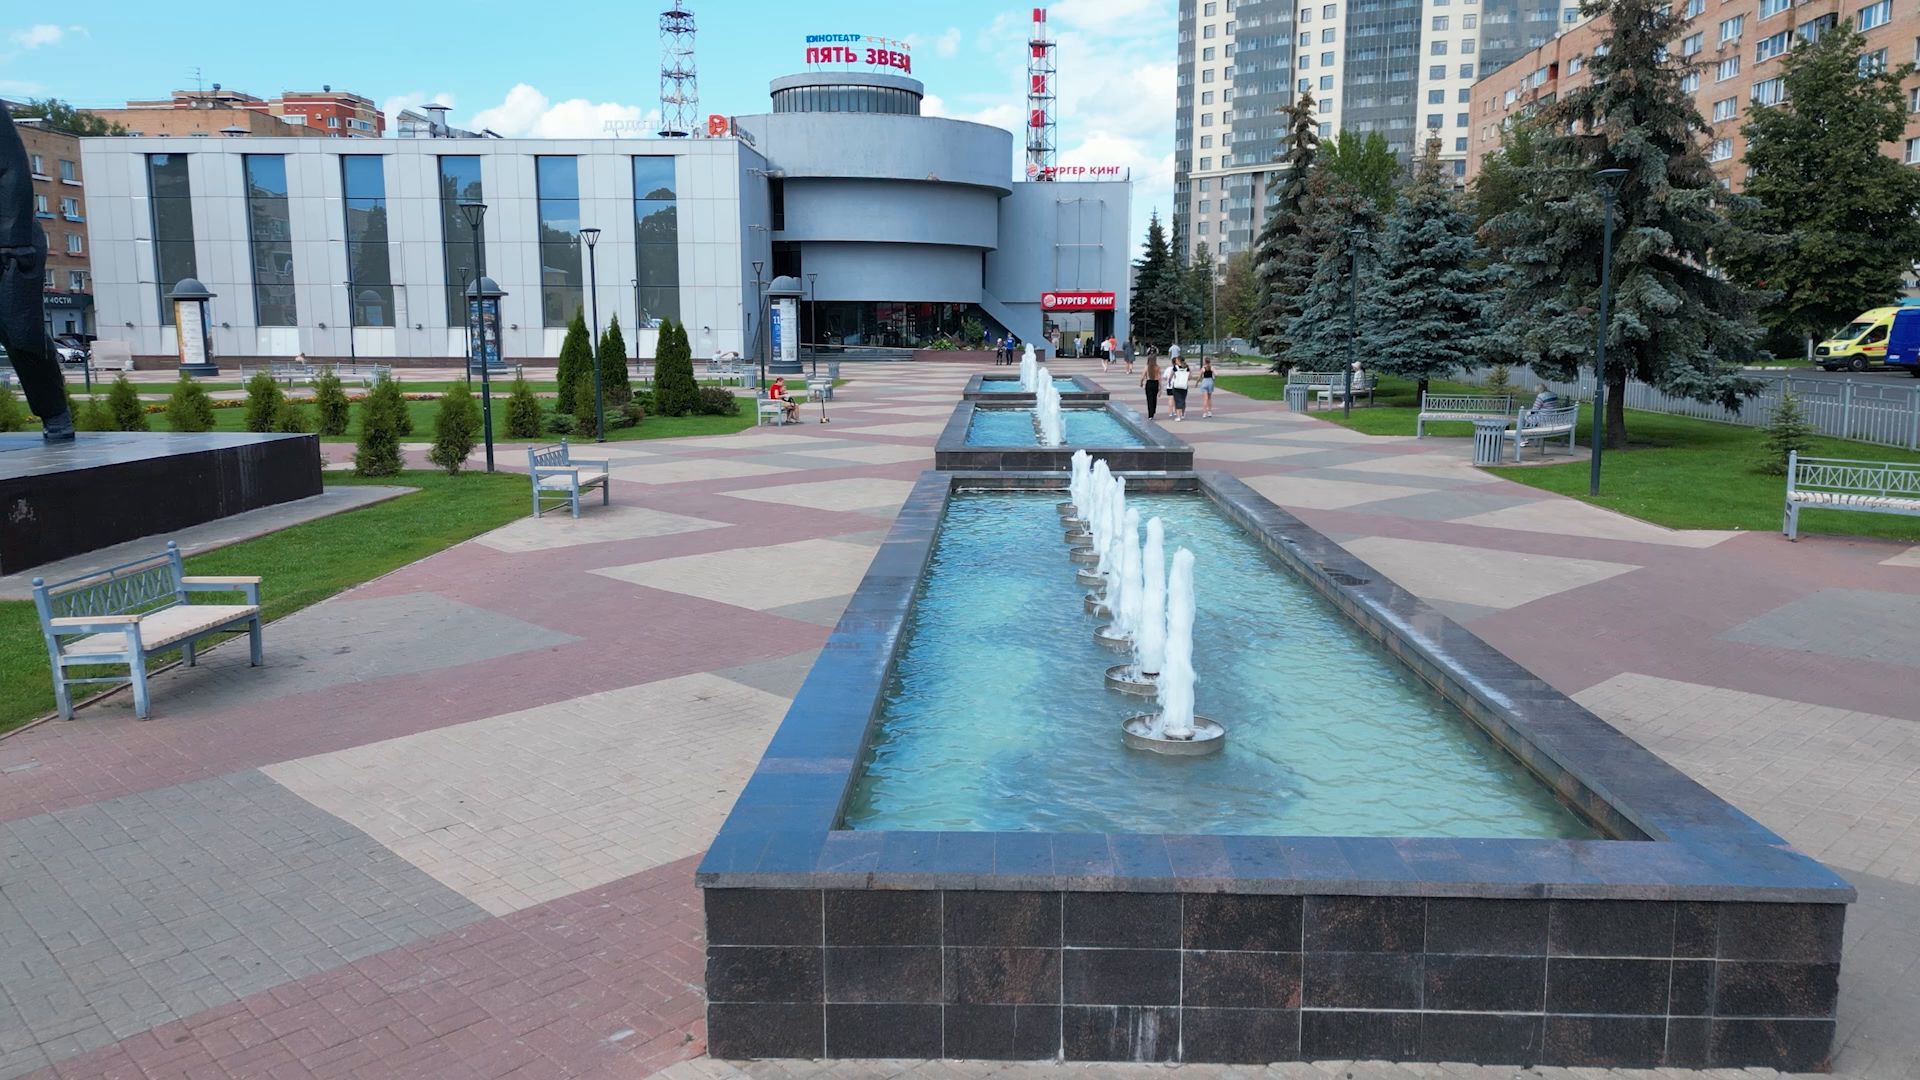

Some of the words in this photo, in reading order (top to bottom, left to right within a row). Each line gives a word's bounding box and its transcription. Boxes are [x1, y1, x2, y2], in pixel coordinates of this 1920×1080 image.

[806, 34, 860, 43] КИНОТЕАТР
[806, 46, 858, 64] ПЯТЬ
[865, 48, 911, 74] ЗВЕЗД
[1044, 166, 1086, 175] БУРГЕР
[1089, 166, 1120, 175] КИНГ
[1056, 296, 1088, 305] БУРГЕР
[1090, 296, 1114, 305] КИНГ
